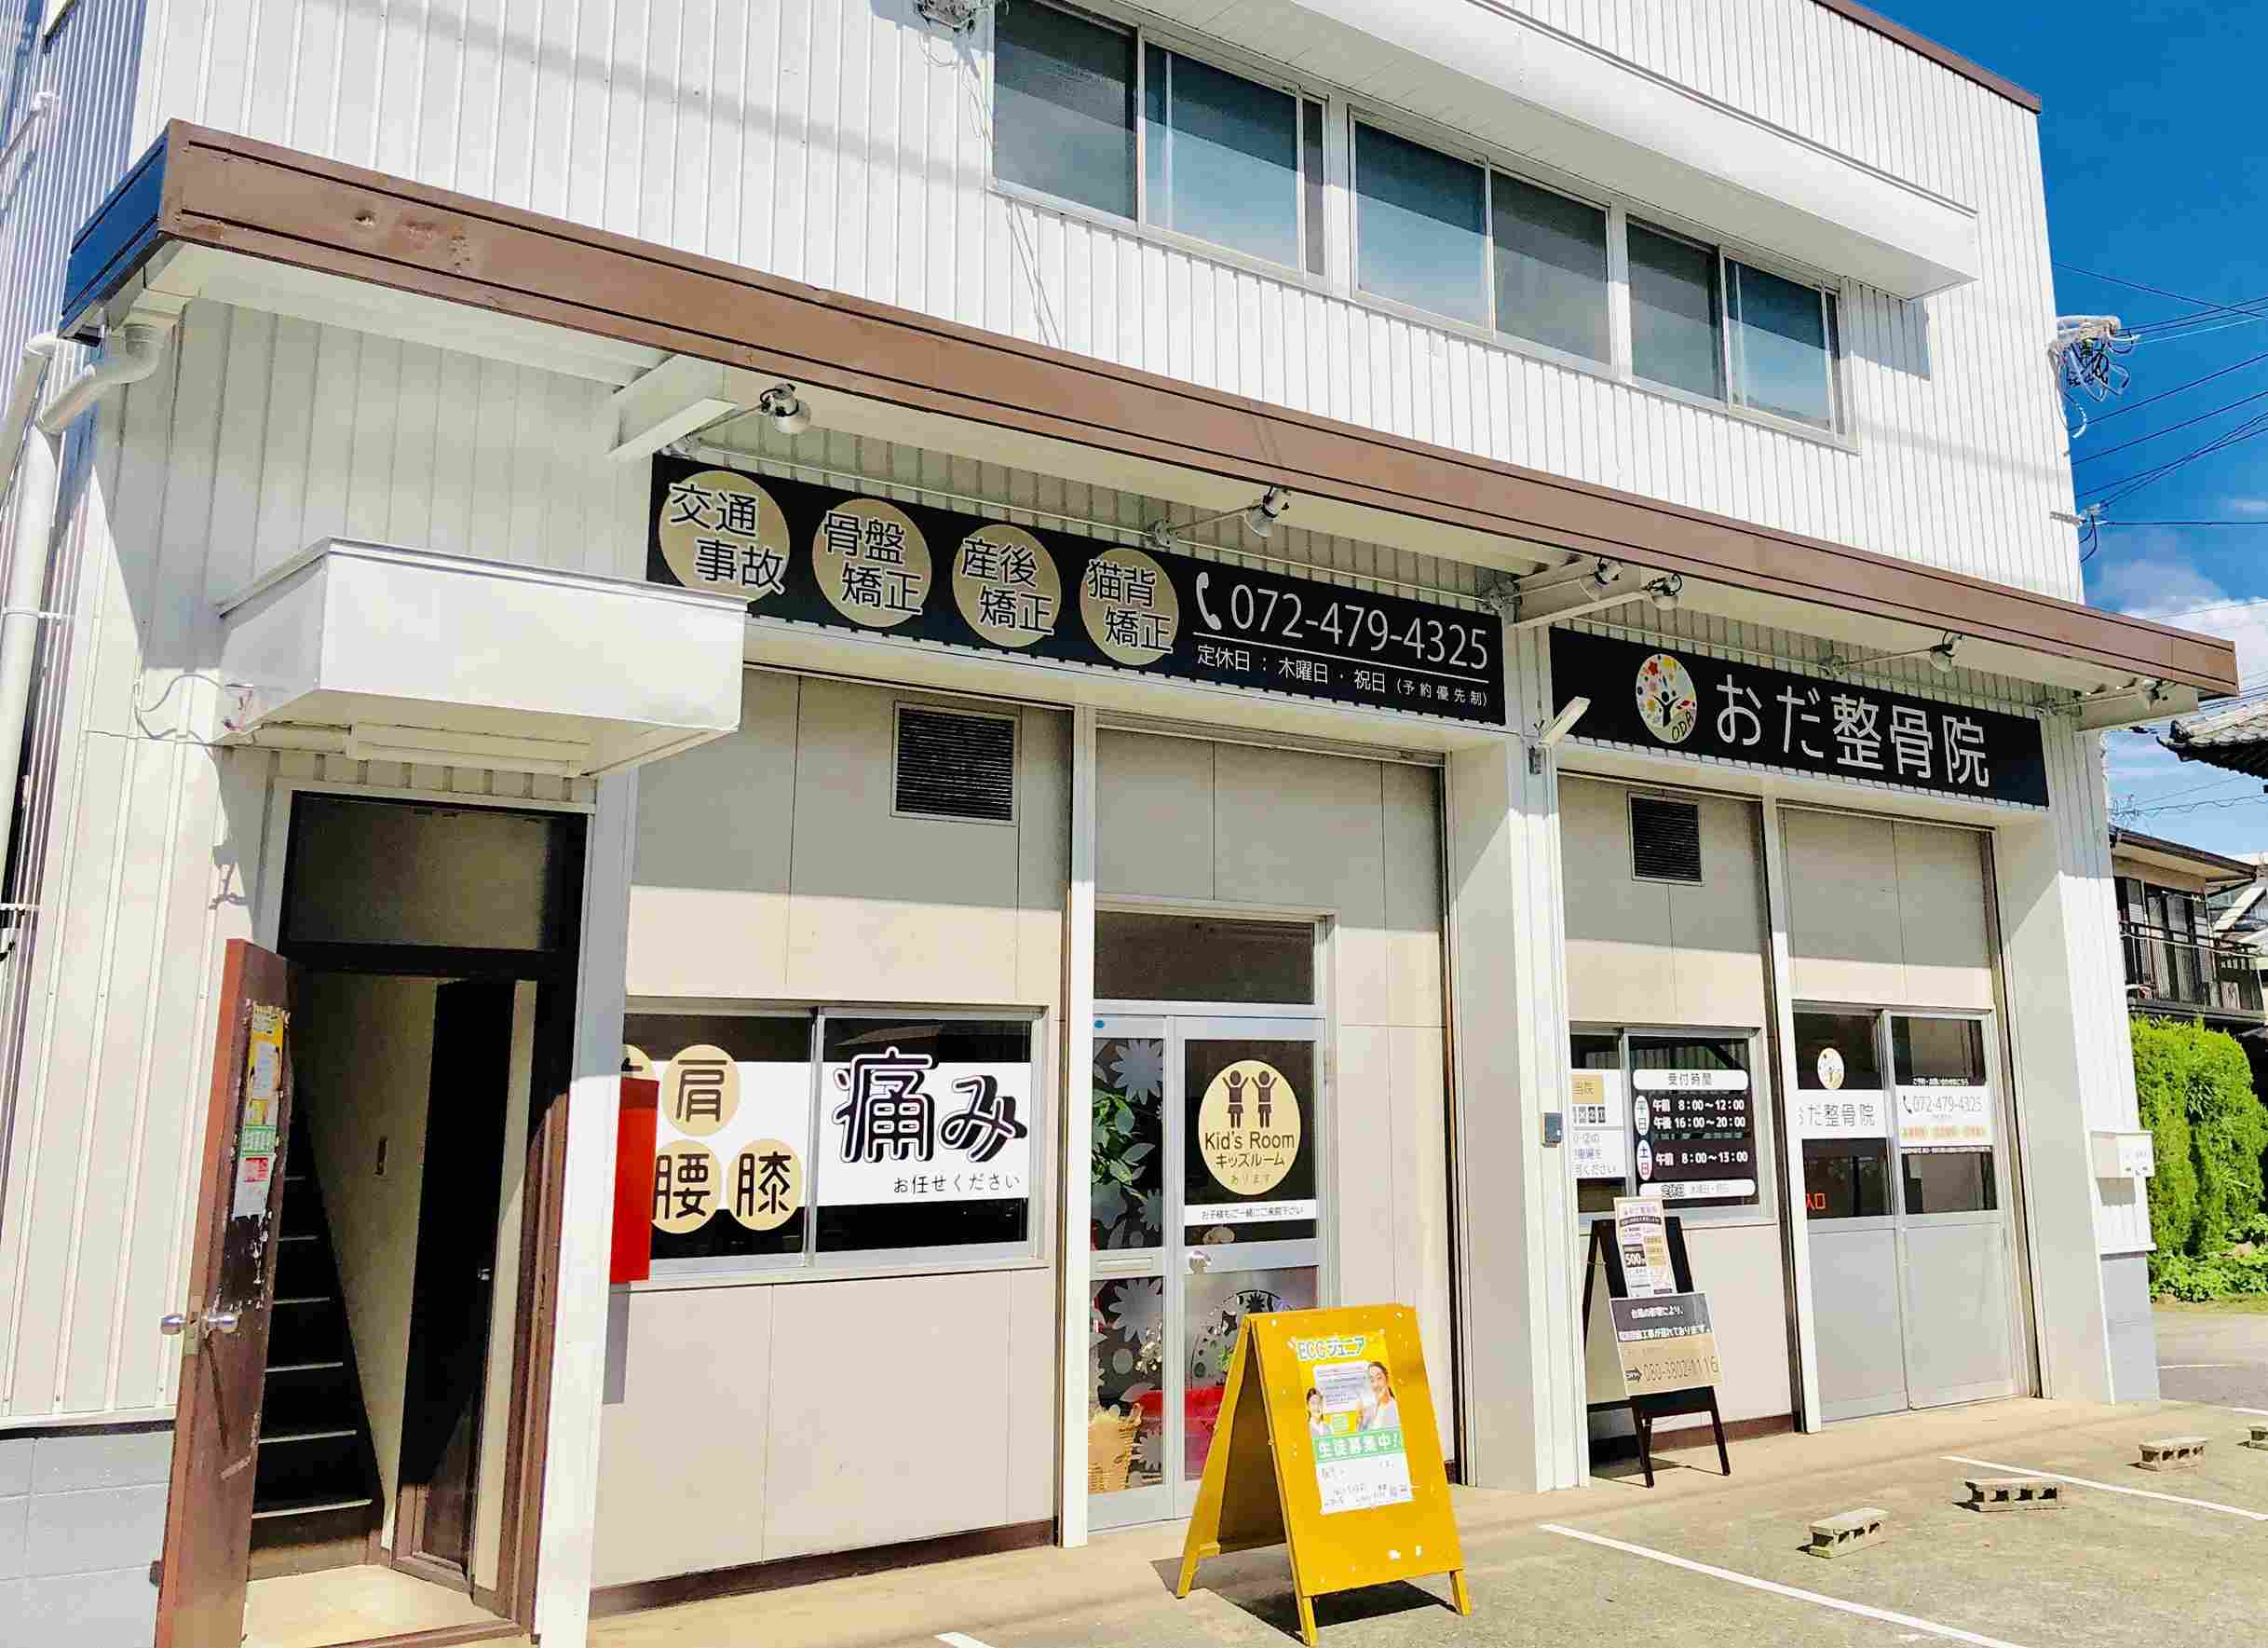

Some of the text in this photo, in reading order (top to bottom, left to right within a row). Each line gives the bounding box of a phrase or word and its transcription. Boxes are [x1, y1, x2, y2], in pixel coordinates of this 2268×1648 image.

[669, 484, 757, 538] 交通
[824, 512, 905, 565] 骨盤
[961, 538, 1037, 587] 産後
[696, 540, 786, 595] 事故
[842, 563, 922, 616] 矯正
[1087, 560, 1155, 607] 猫背
[980, 586, 1054, 636] 矯正
[1105, 606, 1174, 653] 矯正
[1230, 583, 1489, 671] 072-479-4325
[1716, 674, 1990, 788] おだ整骨院
[675, 1059, 727, 1123] 肩
[833, 1046, 1029, 1164] 痛み
[1668, 1072, 1713, 1087] 受付時間
[1205, 1130, 1295, 1151] Kid's Room
[1215, 1151, 1286, 1168] キッズルーム
[653, 1153, 711, 1219] 腰
[737, 1151, 792, 1219] 膝
[893, 1174, 1021, 1195] お任せください
[1230, 1173, 1272, 1187] あります
